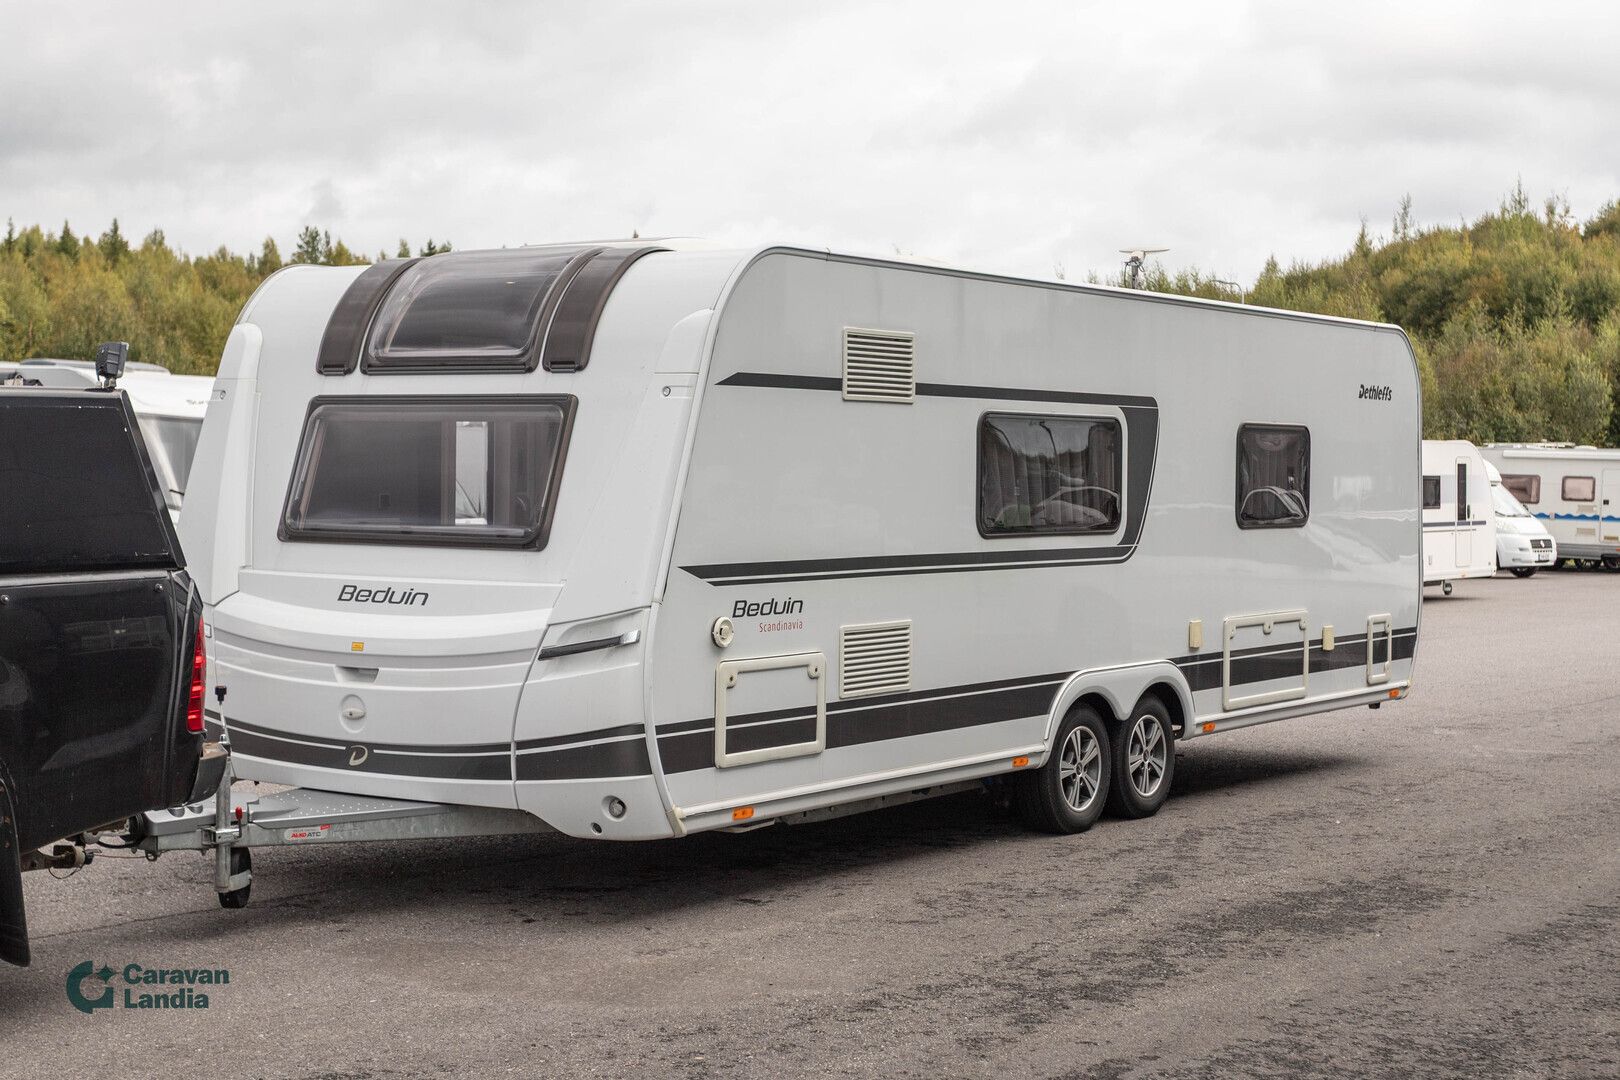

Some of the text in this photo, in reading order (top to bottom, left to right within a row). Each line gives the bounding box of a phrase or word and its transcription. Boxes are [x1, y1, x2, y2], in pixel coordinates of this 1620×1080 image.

[1359, 384, 1392, 401] Dethleffs
[337, 585, 429, 606] Beduin
[732, 597, 804, 618] Beduin
[759, 620, 803, 633] Scandinavia
